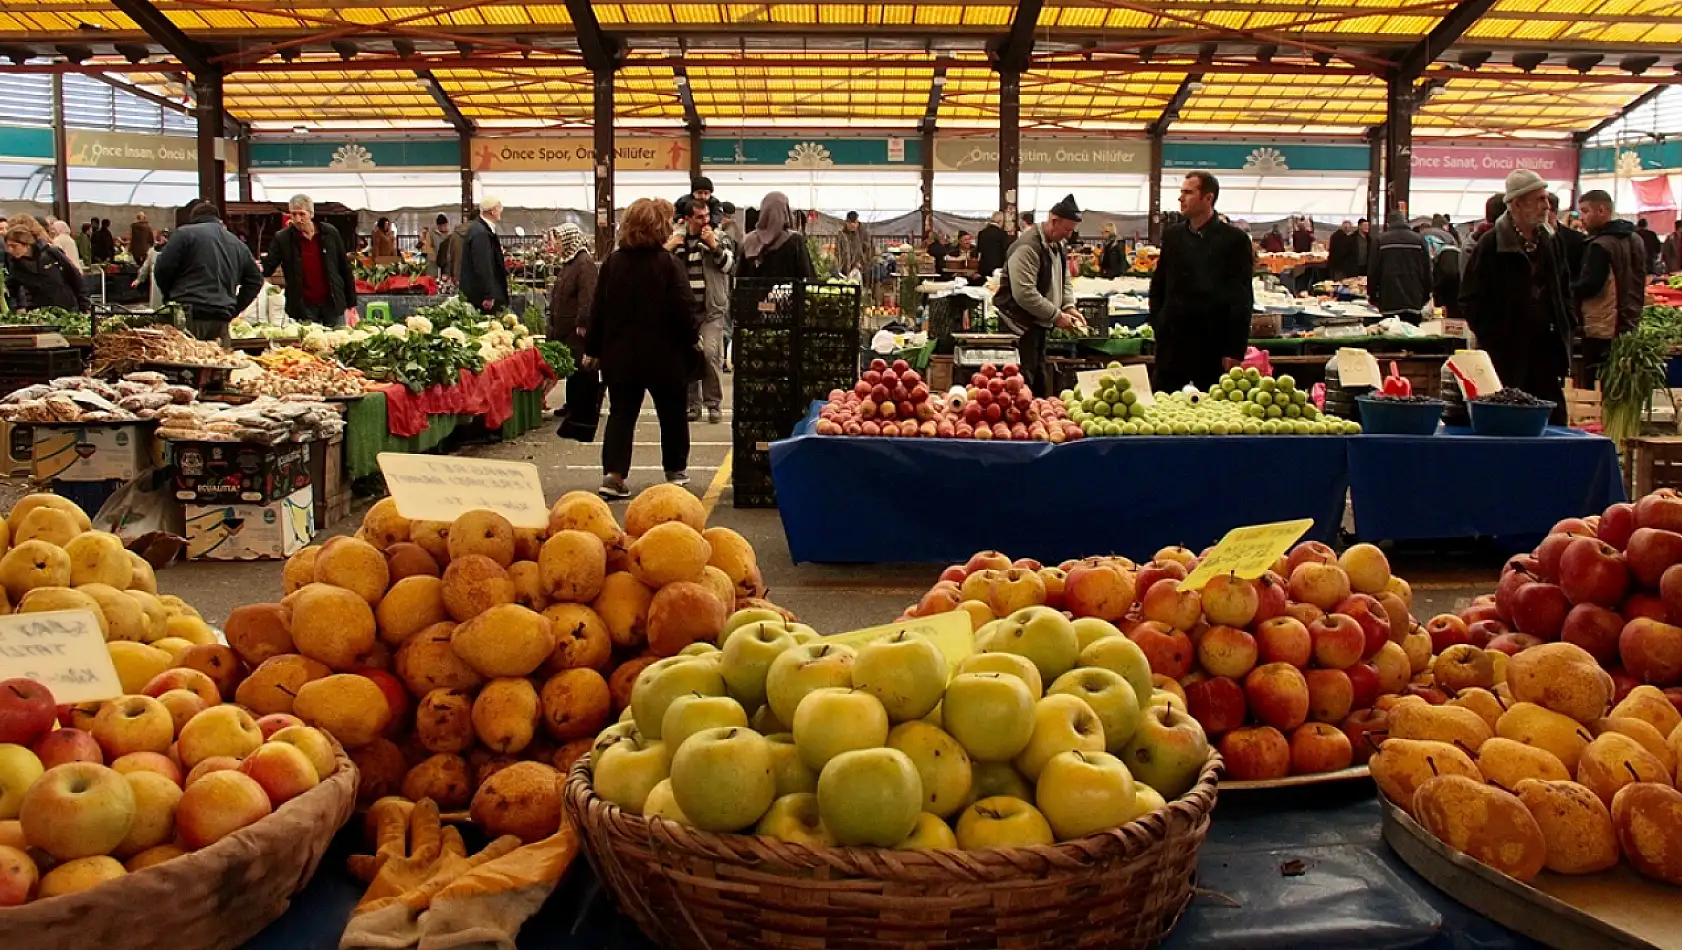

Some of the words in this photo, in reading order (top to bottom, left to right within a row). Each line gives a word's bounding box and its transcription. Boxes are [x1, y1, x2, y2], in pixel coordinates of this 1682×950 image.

[500, 144, 535, 159] Önce
[538, 147, 571, 162] Spor,
[576, 144, 596, 159] Ön
[613, 146, 656, 159] Nilüfer
[971, 145, 999, 161] Önc
[1056, 146, 1089, 162] Öncü
[1093, 149, 1135, 163] Nilüfer
[1443, 156, 1477, 170] Sanat,
[1482, 153, 1513, 169] Öncü
[1516, 157, 1556, 170] Nilüfer
